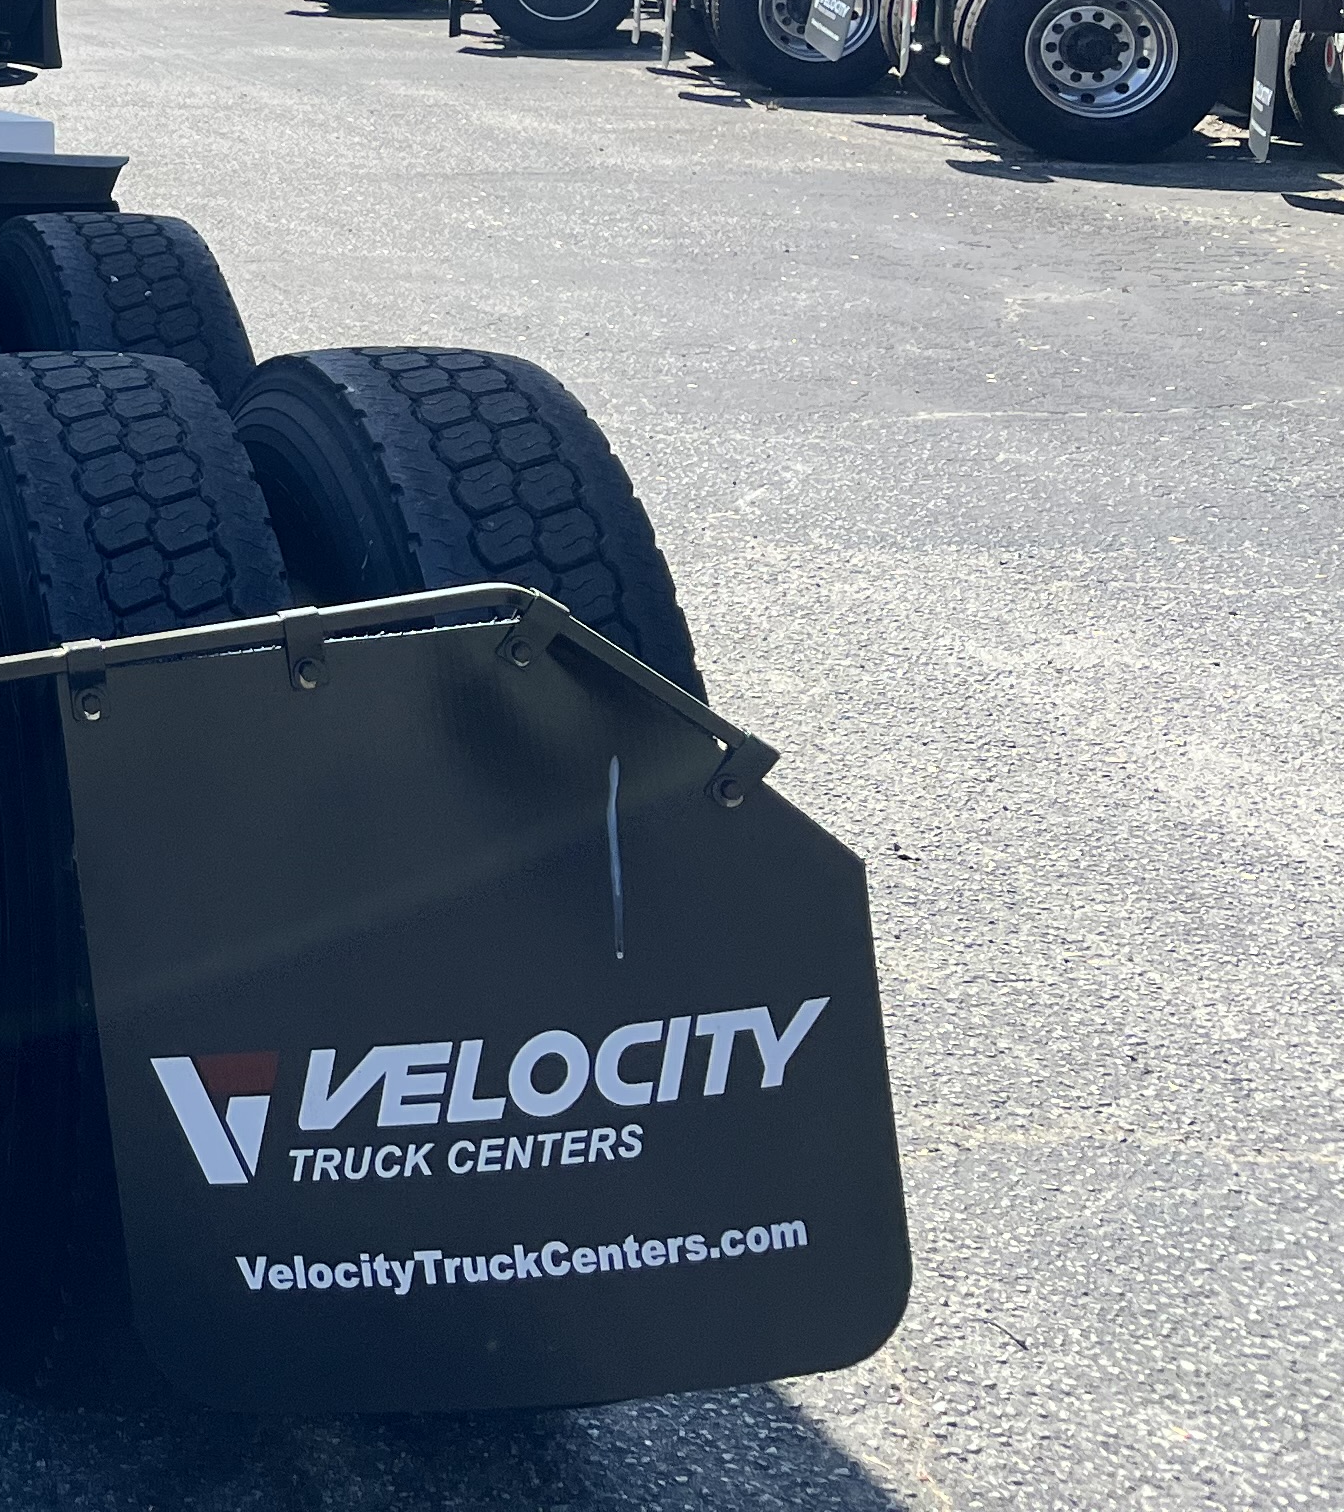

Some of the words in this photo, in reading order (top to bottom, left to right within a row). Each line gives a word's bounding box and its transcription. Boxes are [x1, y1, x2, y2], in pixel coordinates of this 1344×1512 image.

[297, 996, 831, 1131] VELOCITY
[288, 1142, 435, 1182] TRUCK
[447, 1123, 644, 1175] CENTERS
[234, 1220, 808, 1296] VelocityTruckCenters.com
